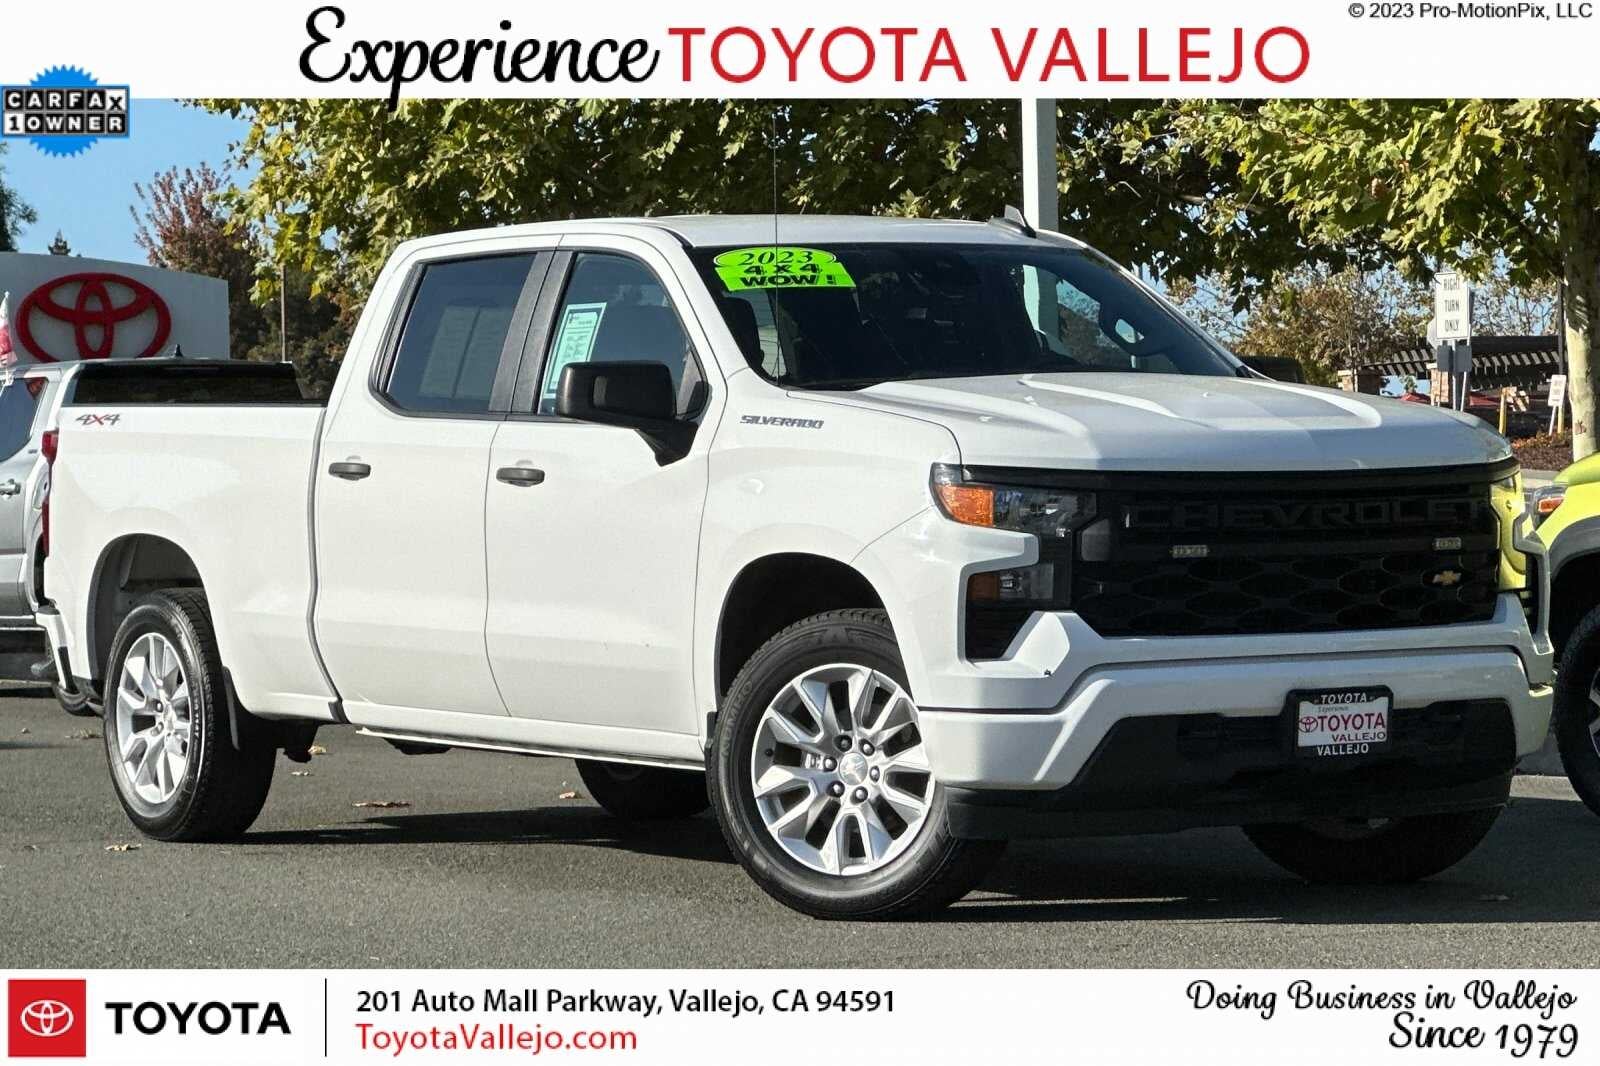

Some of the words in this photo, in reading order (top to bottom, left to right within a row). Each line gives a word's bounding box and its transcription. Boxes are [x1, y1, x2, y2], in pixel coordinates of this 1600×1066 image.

[737, 250, 814, 266] 2023
[1444, 299, 1460, 312] TURN
[1444, 319, 1460, 332] ONLY
[740, 415, 825, 429] SILVERADO
[1320, 692, 1368, 704] TOYOTA
[1317, 712, 1386, 732] TOYOTA
[1331, 732, 1386, 743] VALLEJO
[1316, 743, 1369, 757] VALLEJO
